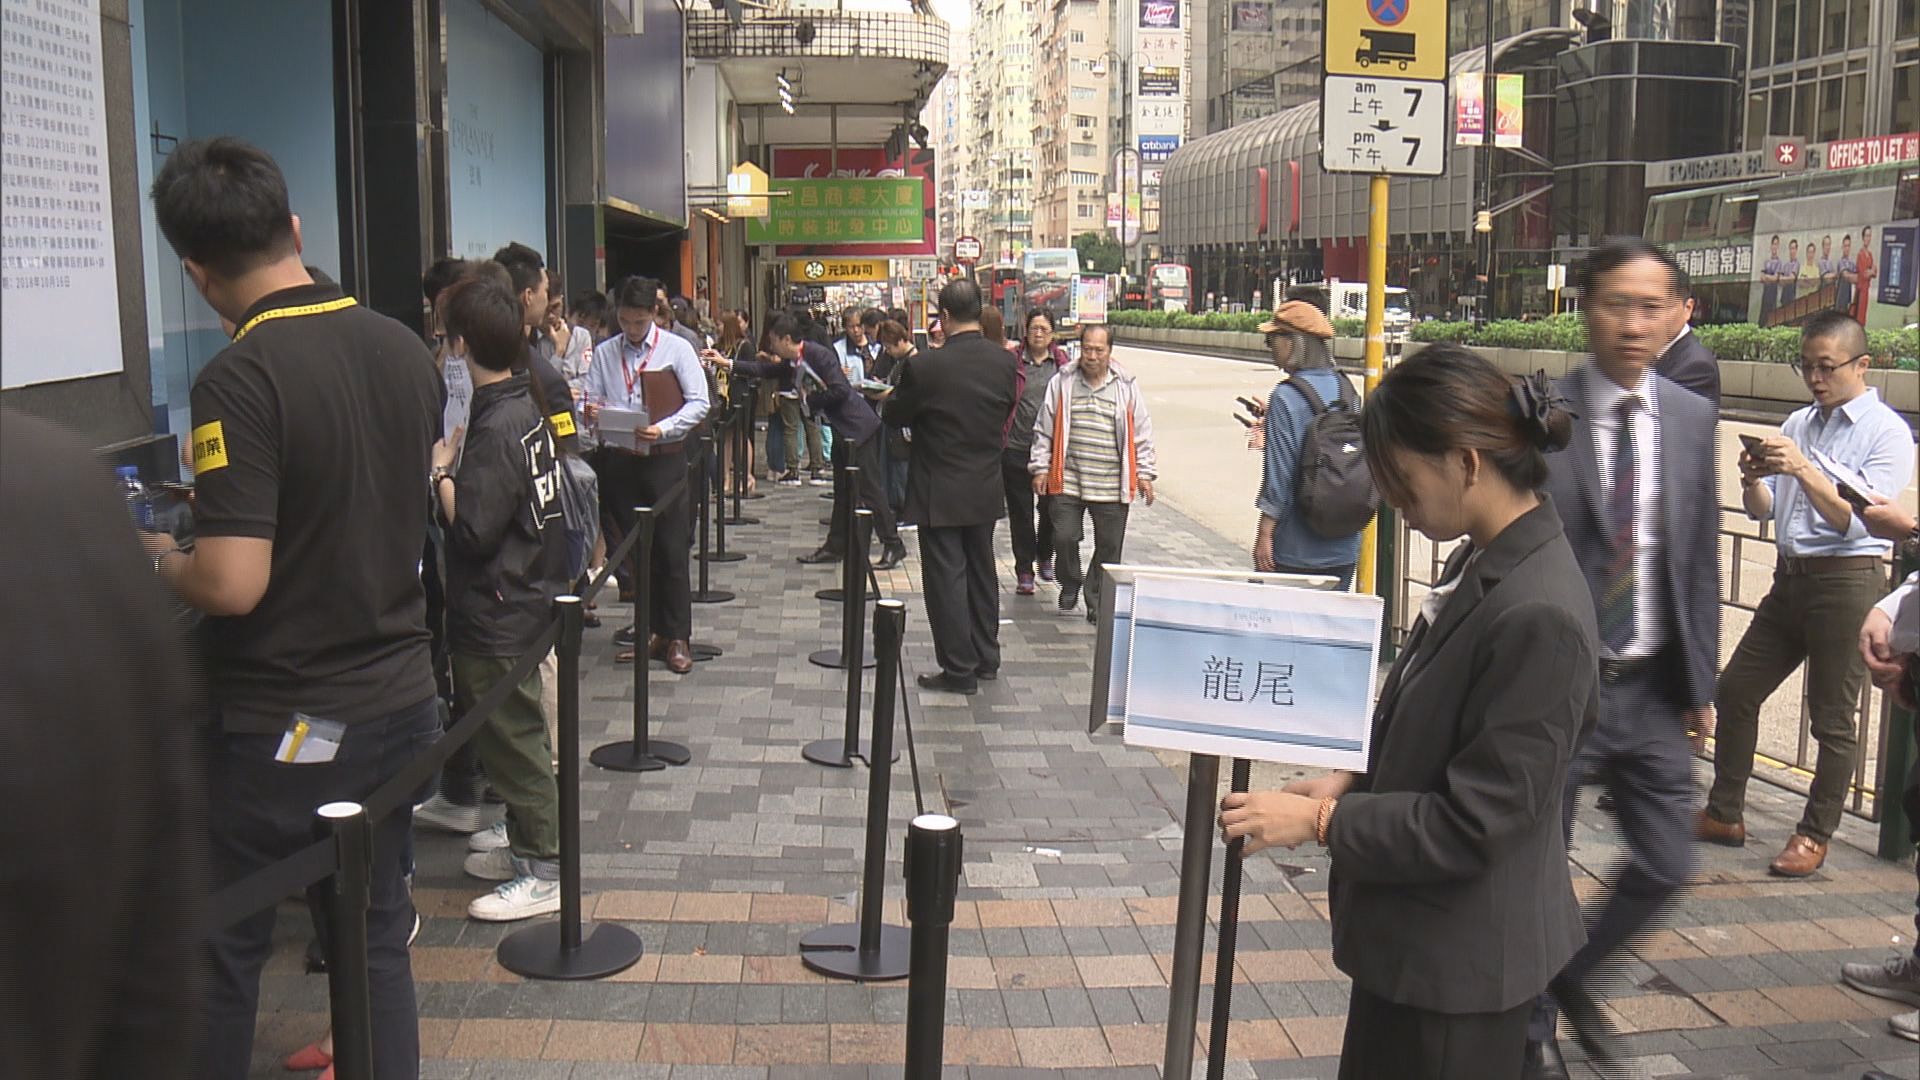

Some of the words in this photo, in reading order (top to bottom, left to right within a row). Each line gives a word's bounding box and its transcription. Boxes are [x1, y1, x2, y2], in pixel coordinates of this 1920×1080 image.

[1355, 83, 1376, 93] am
[1348, 97, 1383, 115] 上午
[1403, 88, 1422, 117] 7
[1353, 132, 1375, 144] pm
[1347, 147, 1381, 165] 下午
[1402, 137, 1421, 166] 7
[1830, 140, 1864, 168] OFFICE
[1867, 137, 1880, 164] TO
[1883, 135, 1903, 161] LET
[1201, 654, 1294, 706] 龍尾
